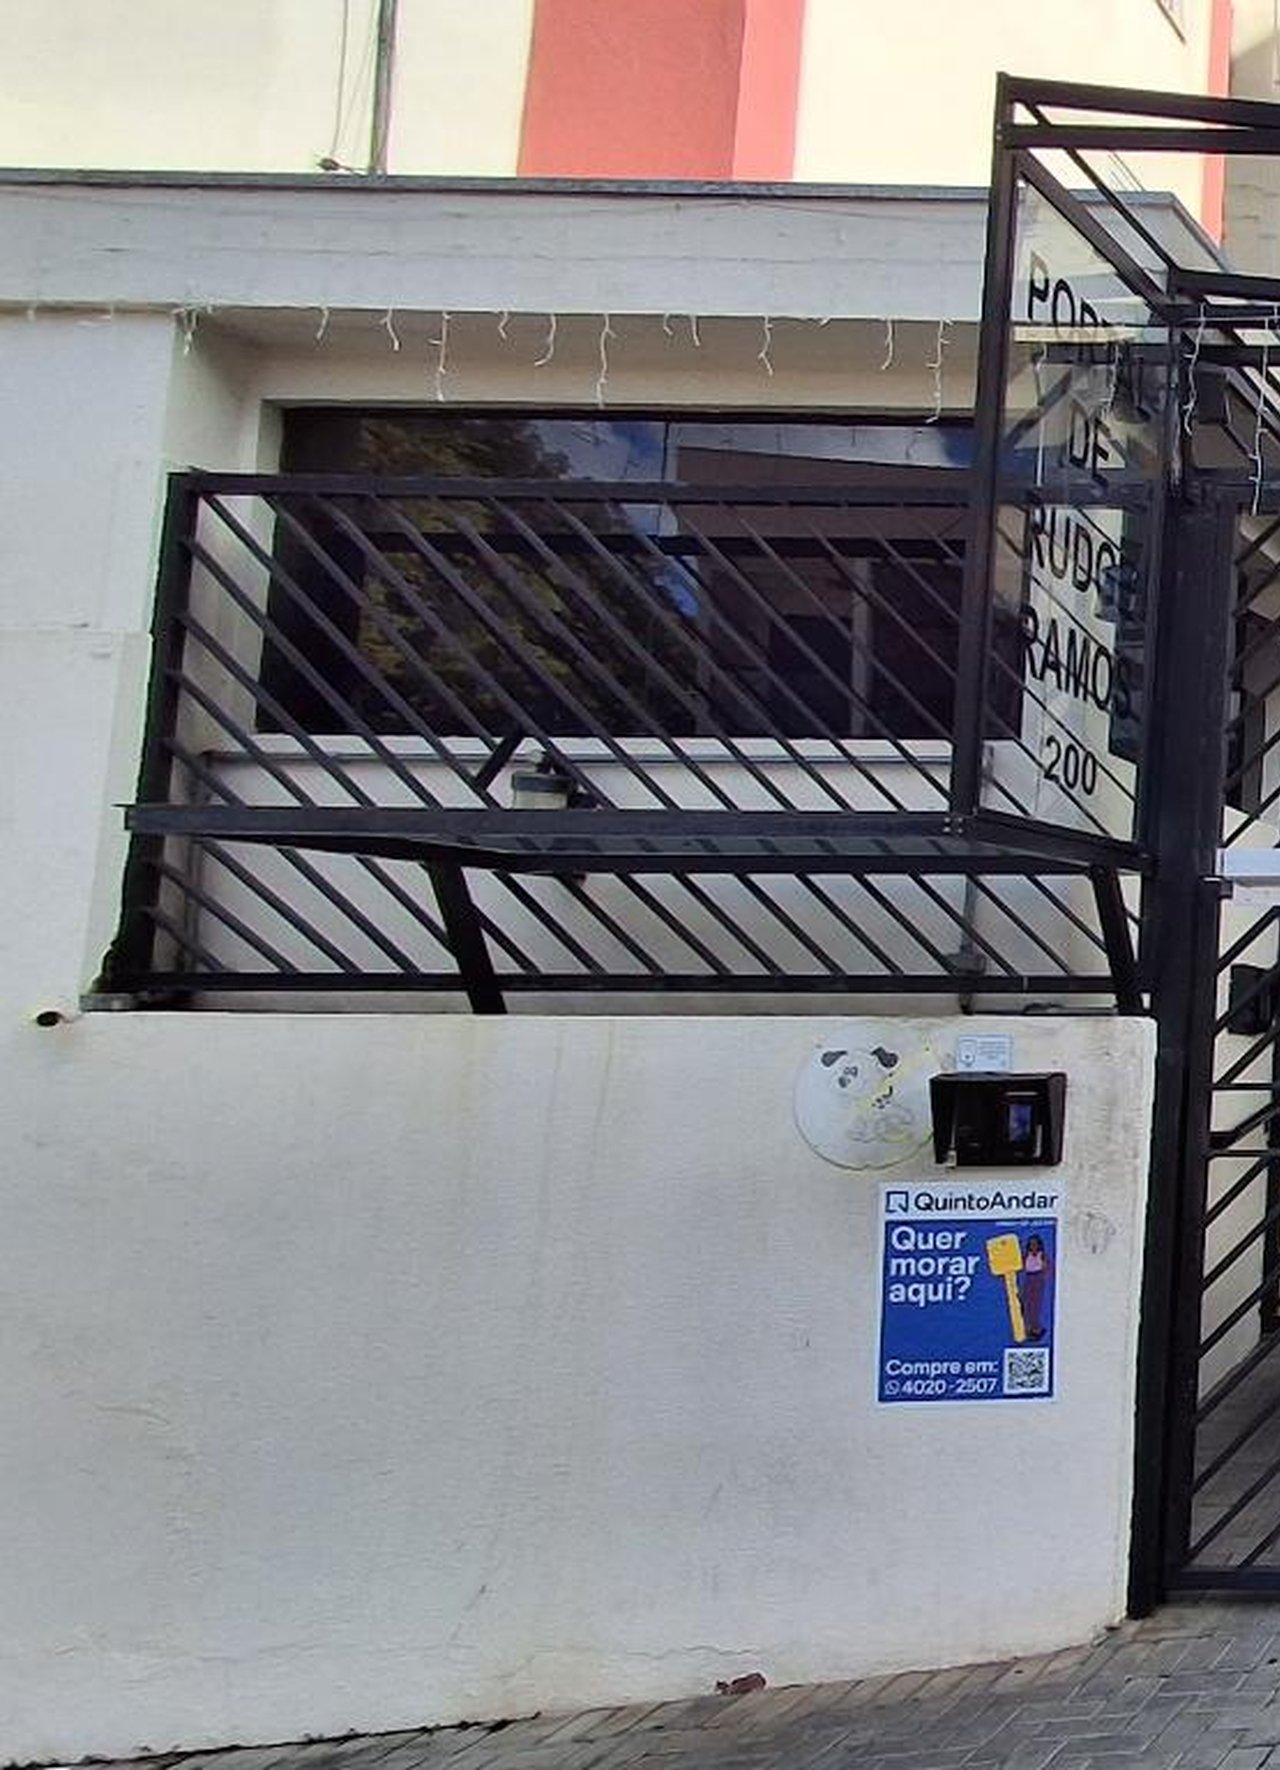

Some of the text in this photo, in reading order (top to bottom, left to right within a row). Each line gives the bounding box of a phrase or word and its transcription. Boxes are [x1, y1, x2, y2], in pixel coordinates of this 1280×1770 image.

[1069, 397, 1109, 488] DE
[1020, 606, 1139, 720] RAMOS
[1044, 735, 1098, 796] 200
[914, 1192, 1058, 1212] QuintoAndar
[891, 1226, 966, 1251] Quer
[890, 1255, 980, 1276] morar
[889, 1277, 971, 1307] aqui?
[885, 1360, 998, 1377] Compre em:
